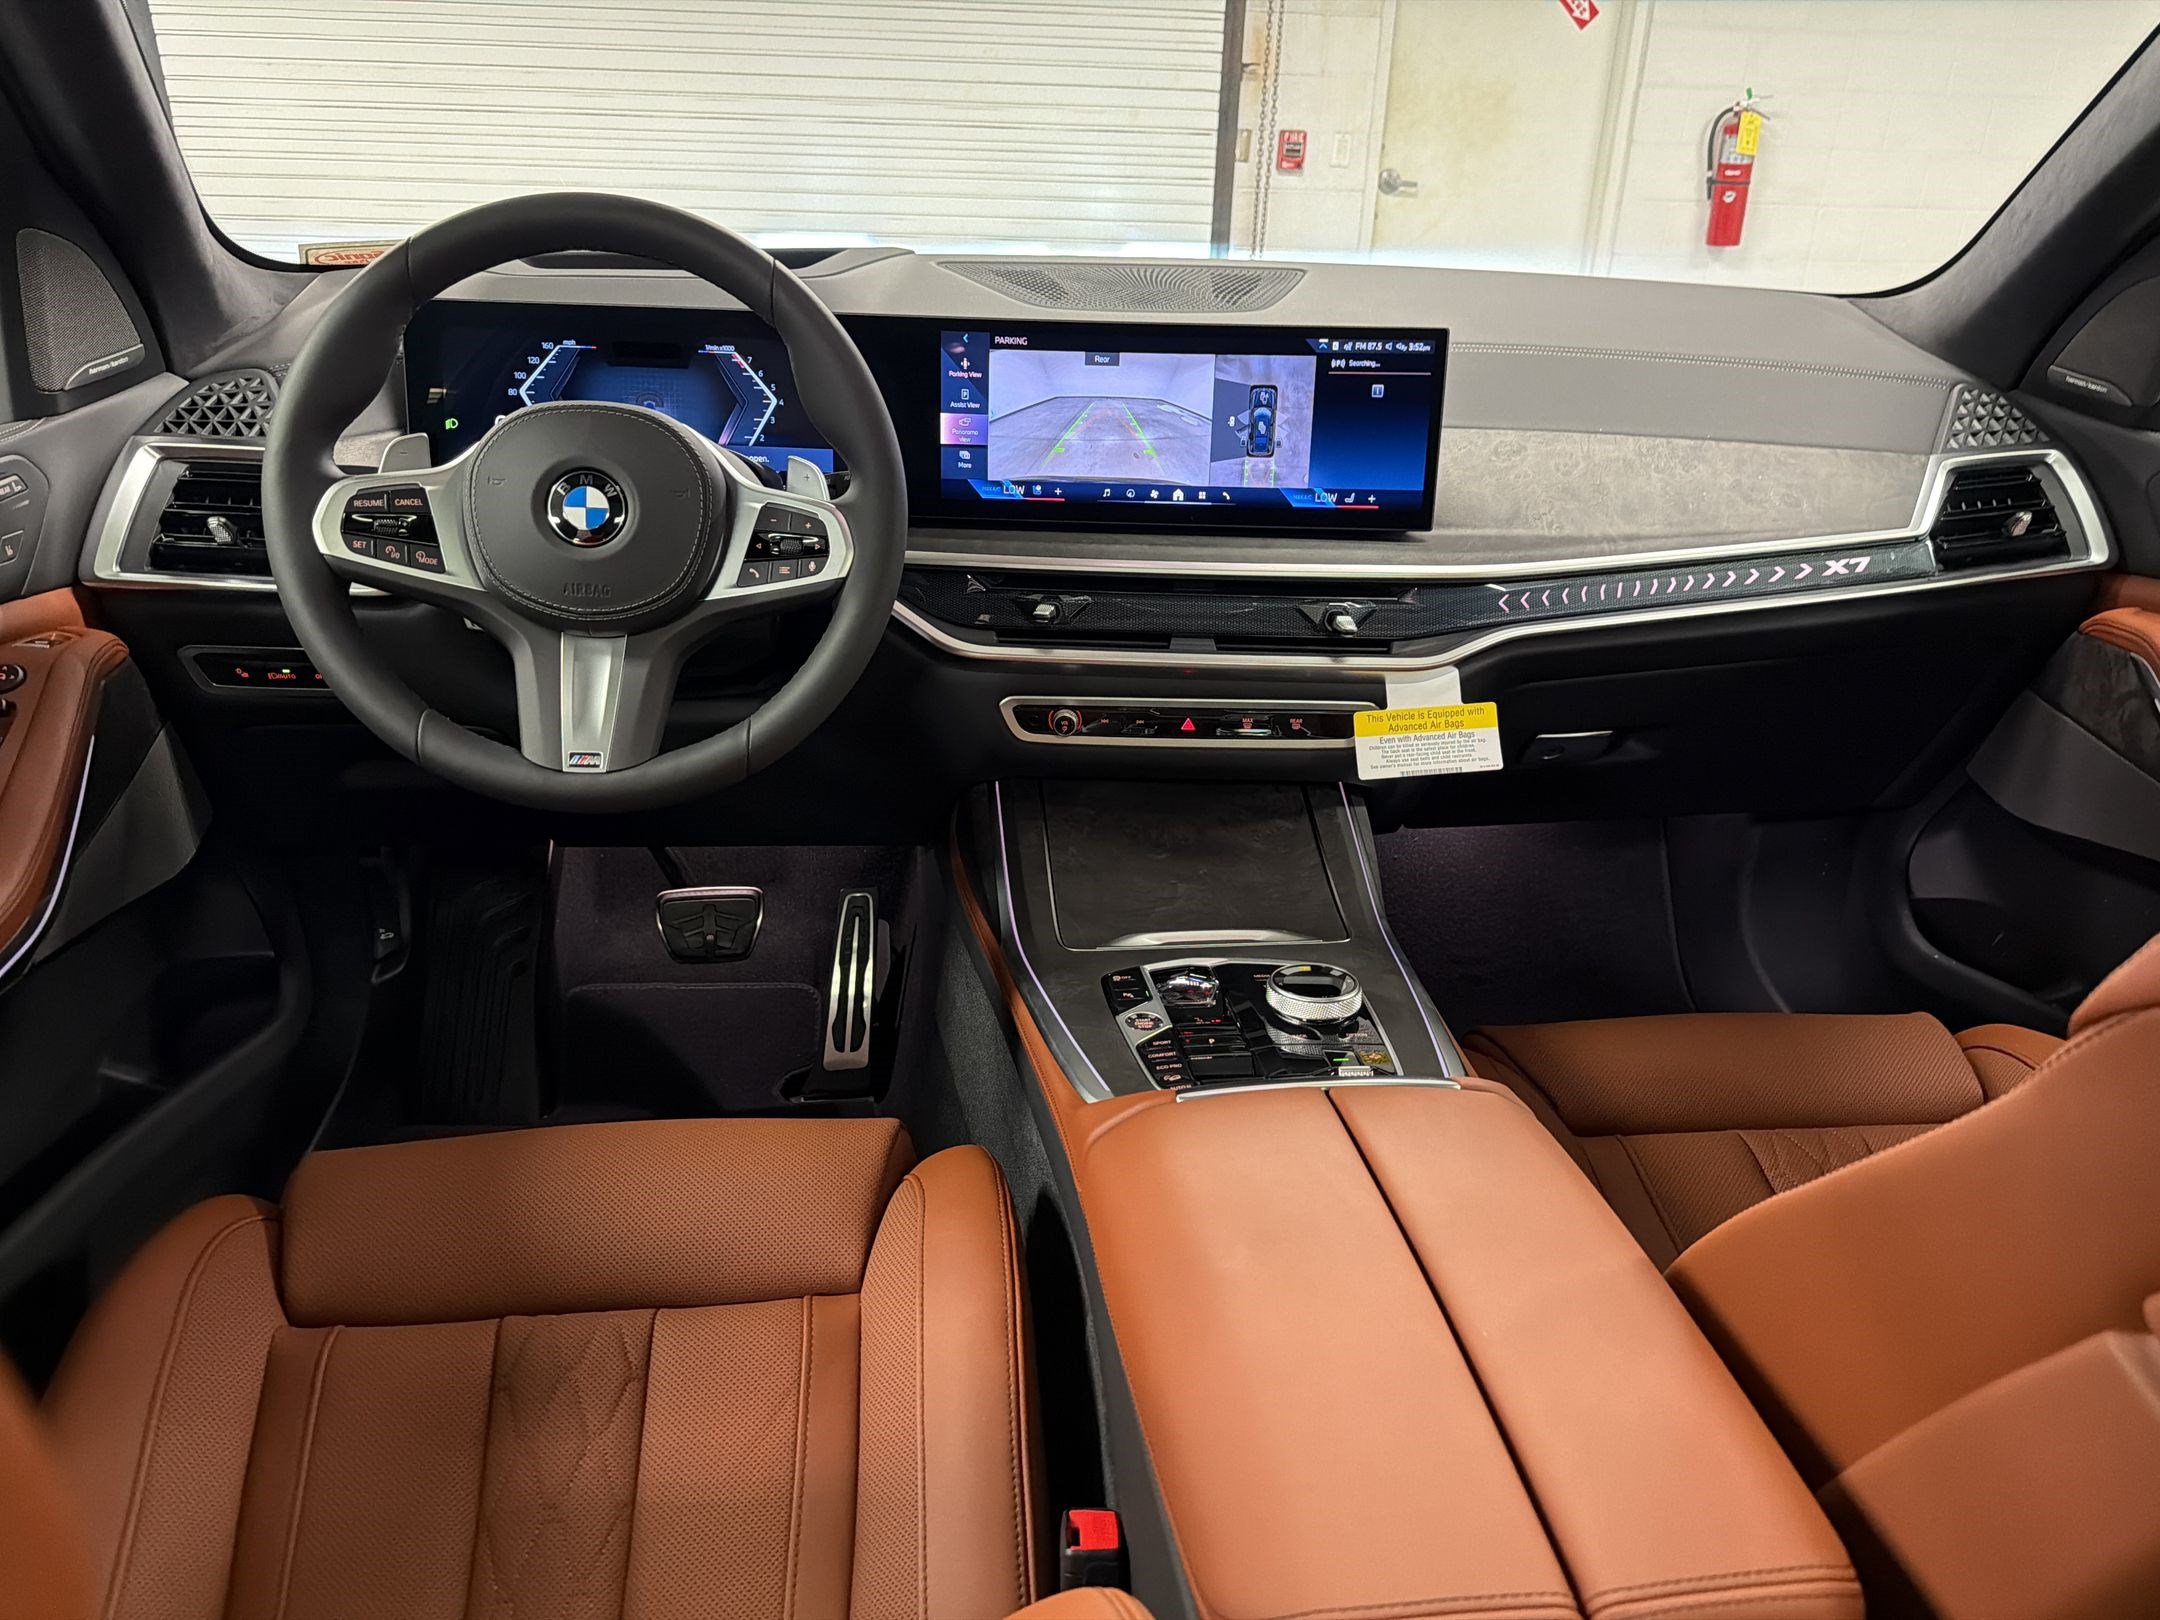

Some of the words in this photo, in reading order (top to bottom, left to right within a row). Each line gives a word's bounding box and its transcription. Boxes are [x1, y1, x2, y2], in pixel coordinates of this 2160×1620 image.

[994, 336, 1028, 345] PARKING
[541, 342, 553, 350] 160
[1355, 342, 1367, 351] FM
[1367, 342, 1382, 351] 87.5
[1094, 355, 1110, 363] Rear
[949, 370, 968, 379] Parking
[508, 388, 517, 396] 80
[951, 428, 979, 436] Panorama
[957, 461, 972, 469] More
[1003, 485, 1025, 494] LOW
[394, 498, 423, 506] CANCEL
[1315, 493, 1337, 502] LOW
[353, 499, 384, 507] RESUME
[352, 540, 367, 548] SET
[419, 556, 438, 565] MODE
[1821, 556, 1871, 576] X7
[563, 582, 612, 597] AIRBAG
[1367, 715, 1384, 723] This
[1386, 712, 1415, 722] Vehicle
[1427, 709, 1465, 720] Equipped
[1467, 707, 1485, 716] with
[1388, 721, 1427, 732] Advanced
[1430, 720, 1441, 729] Air
[1444, 719, 1464, 729] Bags
[1397, 735, 1412, 743] with
[1413, 733, 1445, 742] Advanced
[1447, 731, 1457, 739] Air
[1458, 731, 1475, 739] Bags
